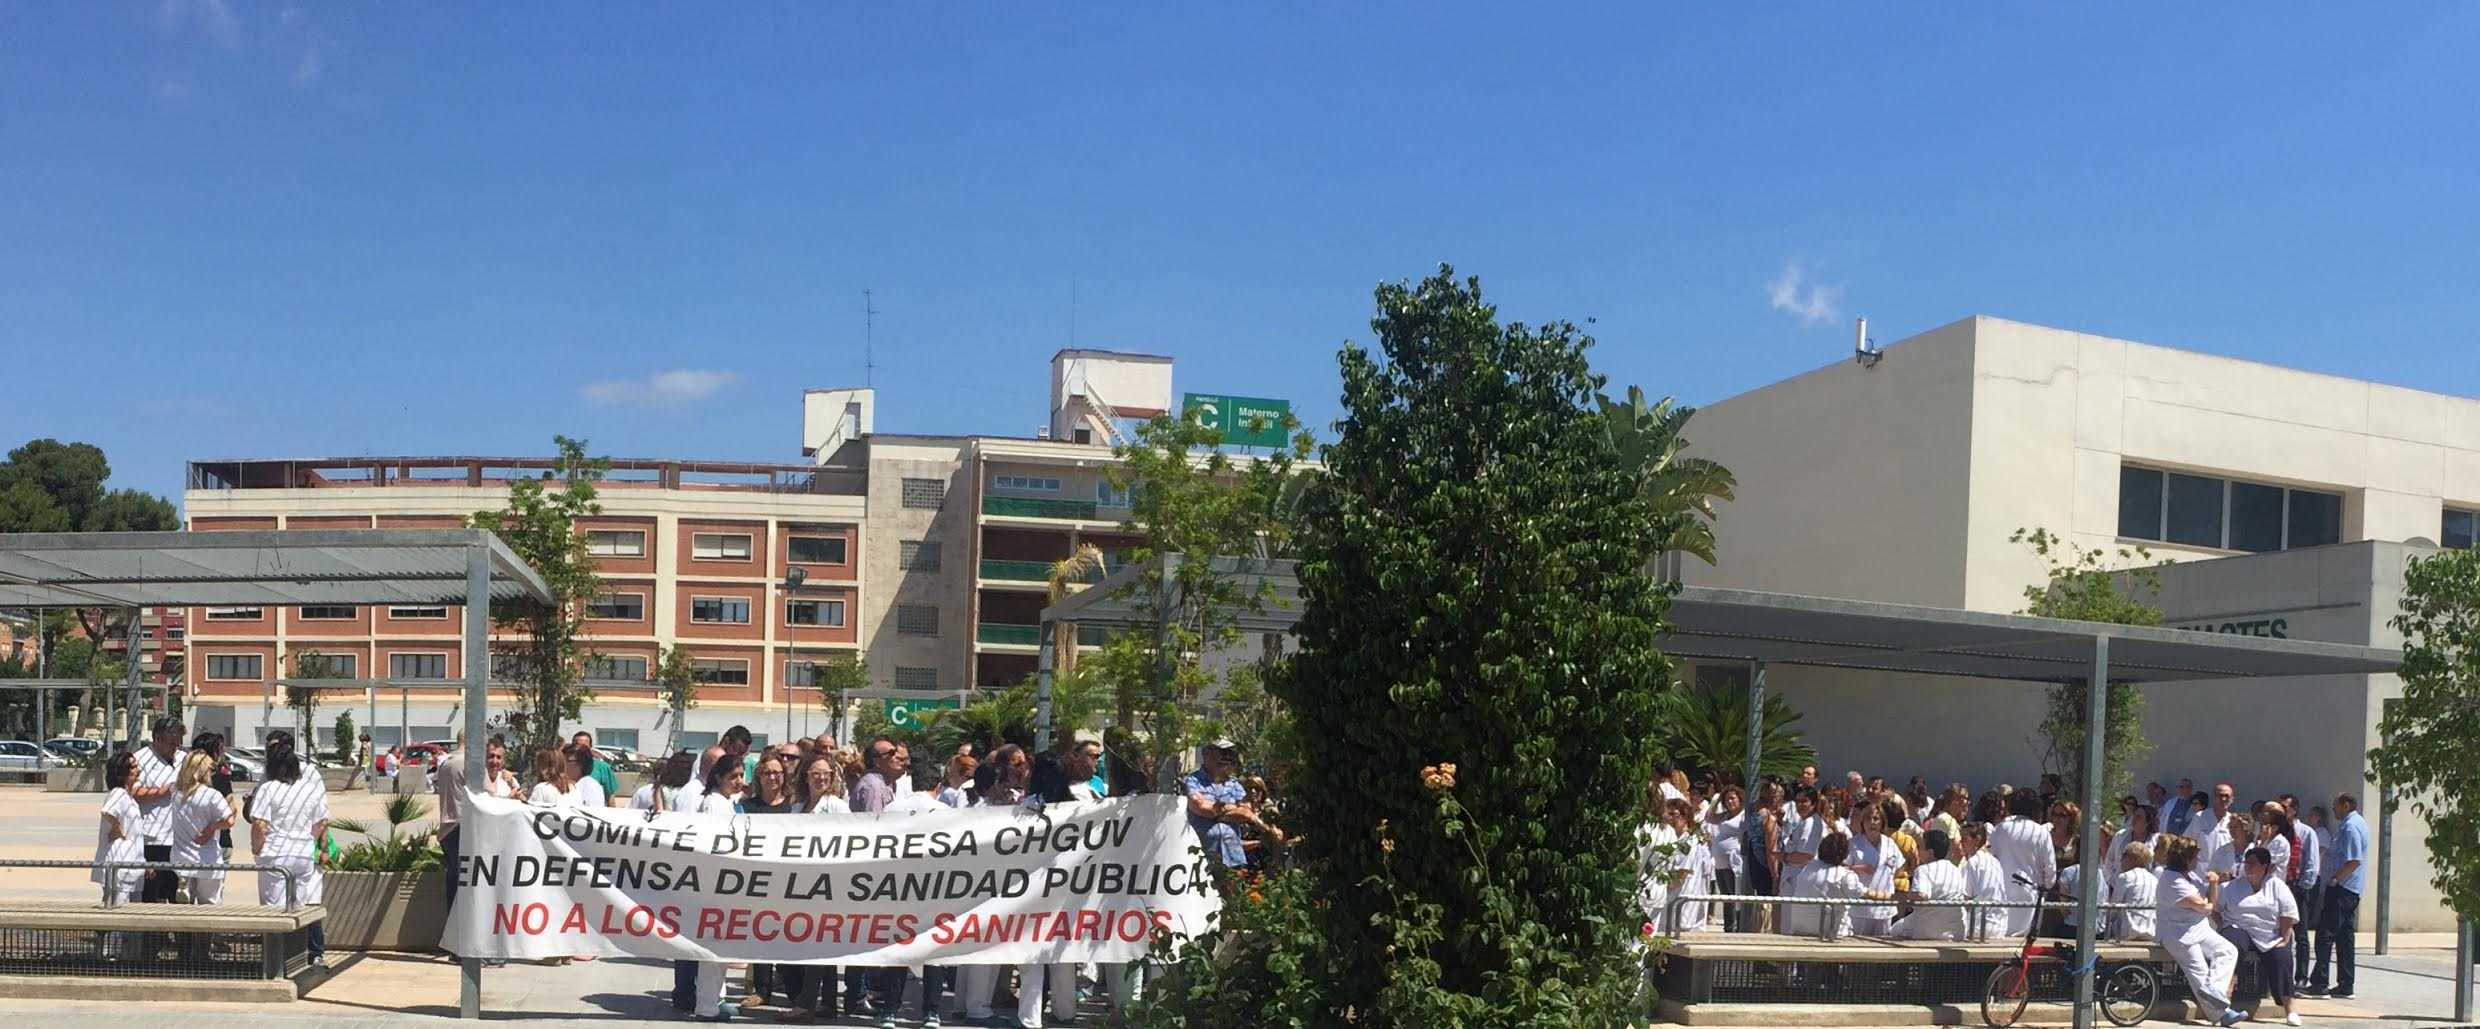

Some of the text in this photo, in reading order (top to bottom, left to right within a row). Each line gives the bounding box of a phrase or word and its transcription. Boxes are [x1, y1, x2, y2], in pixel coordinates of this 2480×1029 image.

[1238, 406, 1280, 418] Materno
[891, 706, 908, 725] C
[533, 810, 1133, 859] COMITÉ DE EMPRESA CHGUV
[457, 855, 1204, 901] EN DEFENSA DE LA SANIDAD PÚBLICA
[492, 902, 549, 935] NO
[560, 903, 587, 934] A
[601, 904, 682, 939] LOS
[696, 907, 919, 945] RECORTES
